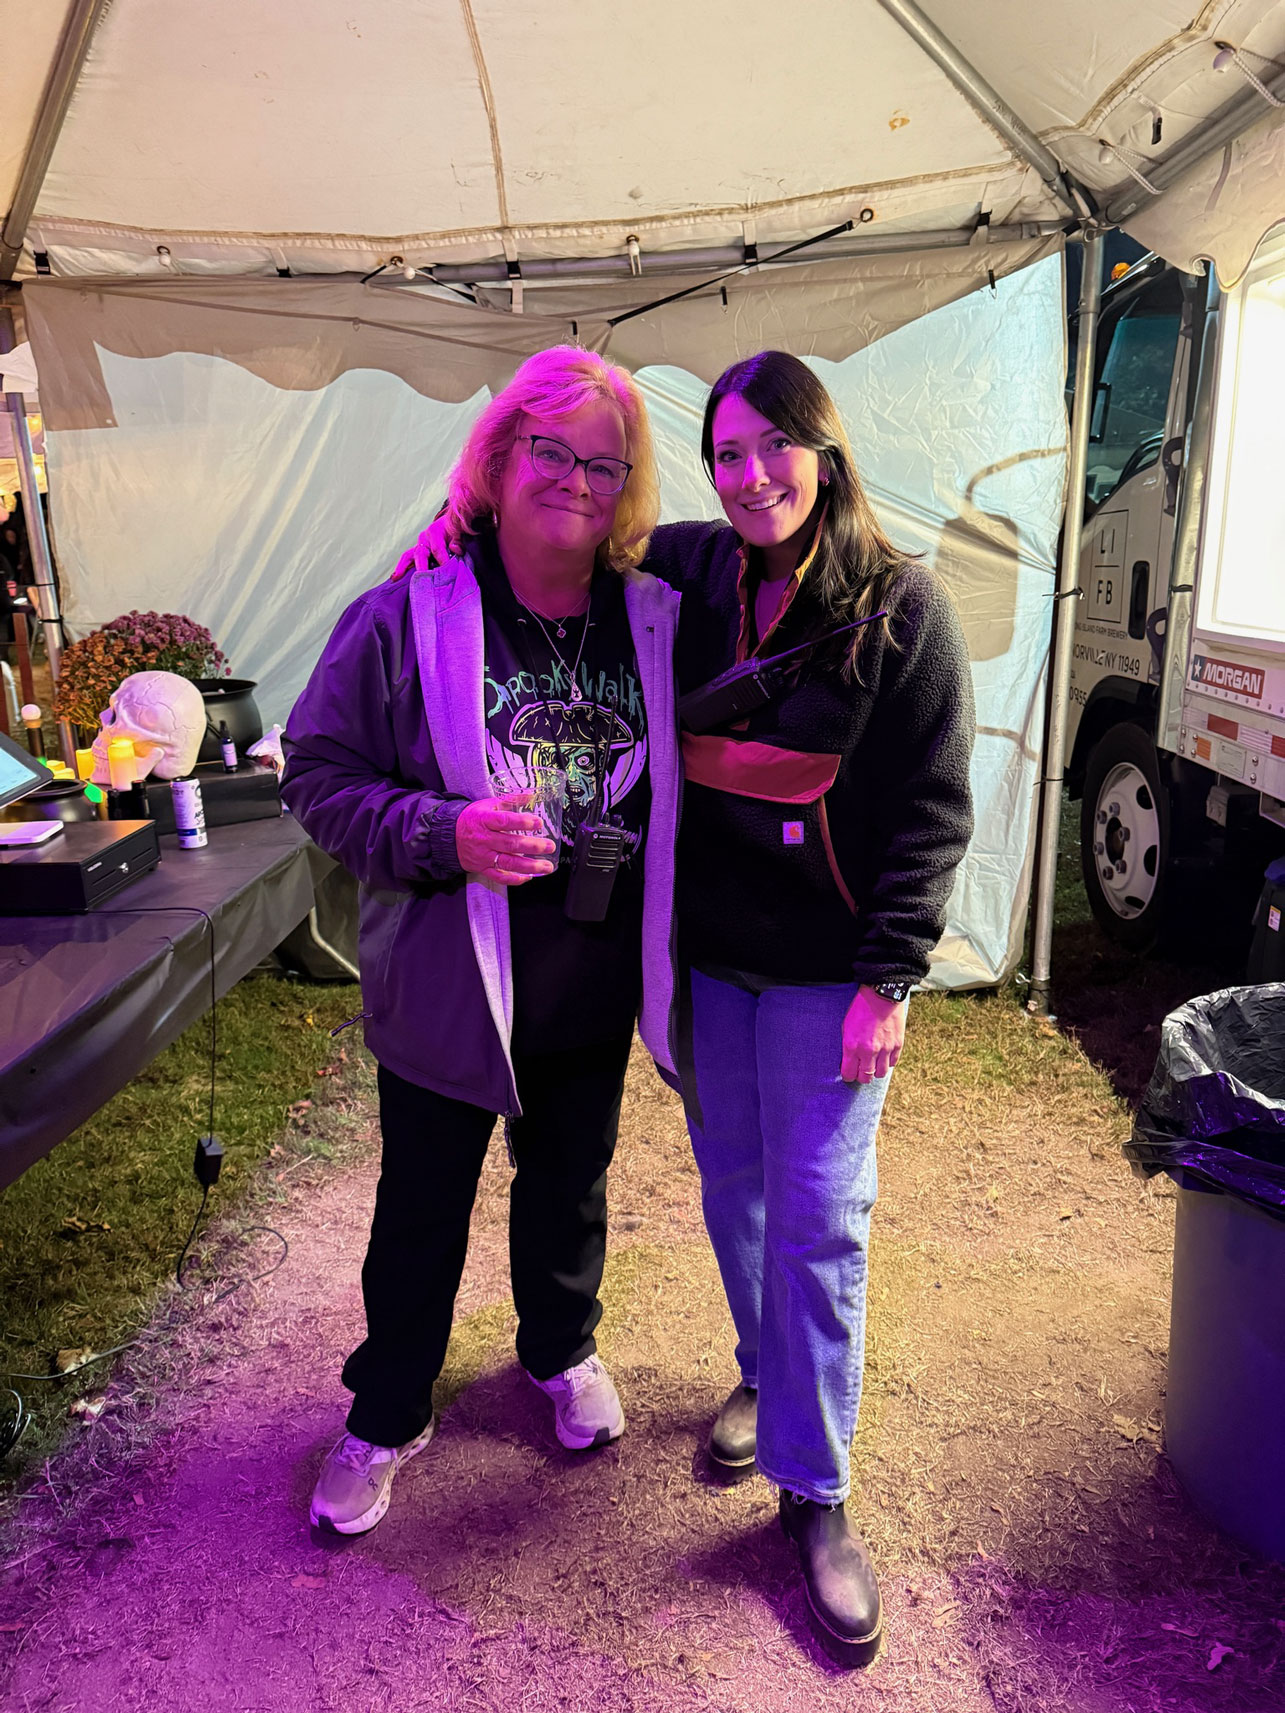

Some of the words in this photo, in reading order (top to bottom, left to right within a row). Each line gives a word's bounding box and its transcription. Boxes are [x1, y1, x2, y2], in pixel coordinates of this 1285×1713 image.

[1100, 528, 1116, 554] LI
[1096, 579, 1113, 605] FB
[1105, 651, 1117, 669] NY
[1118, 655, 1140, 676] 11949
[1203, 662, 1262, 695] MORGAN
[581, 661, 643, 737] Walk
